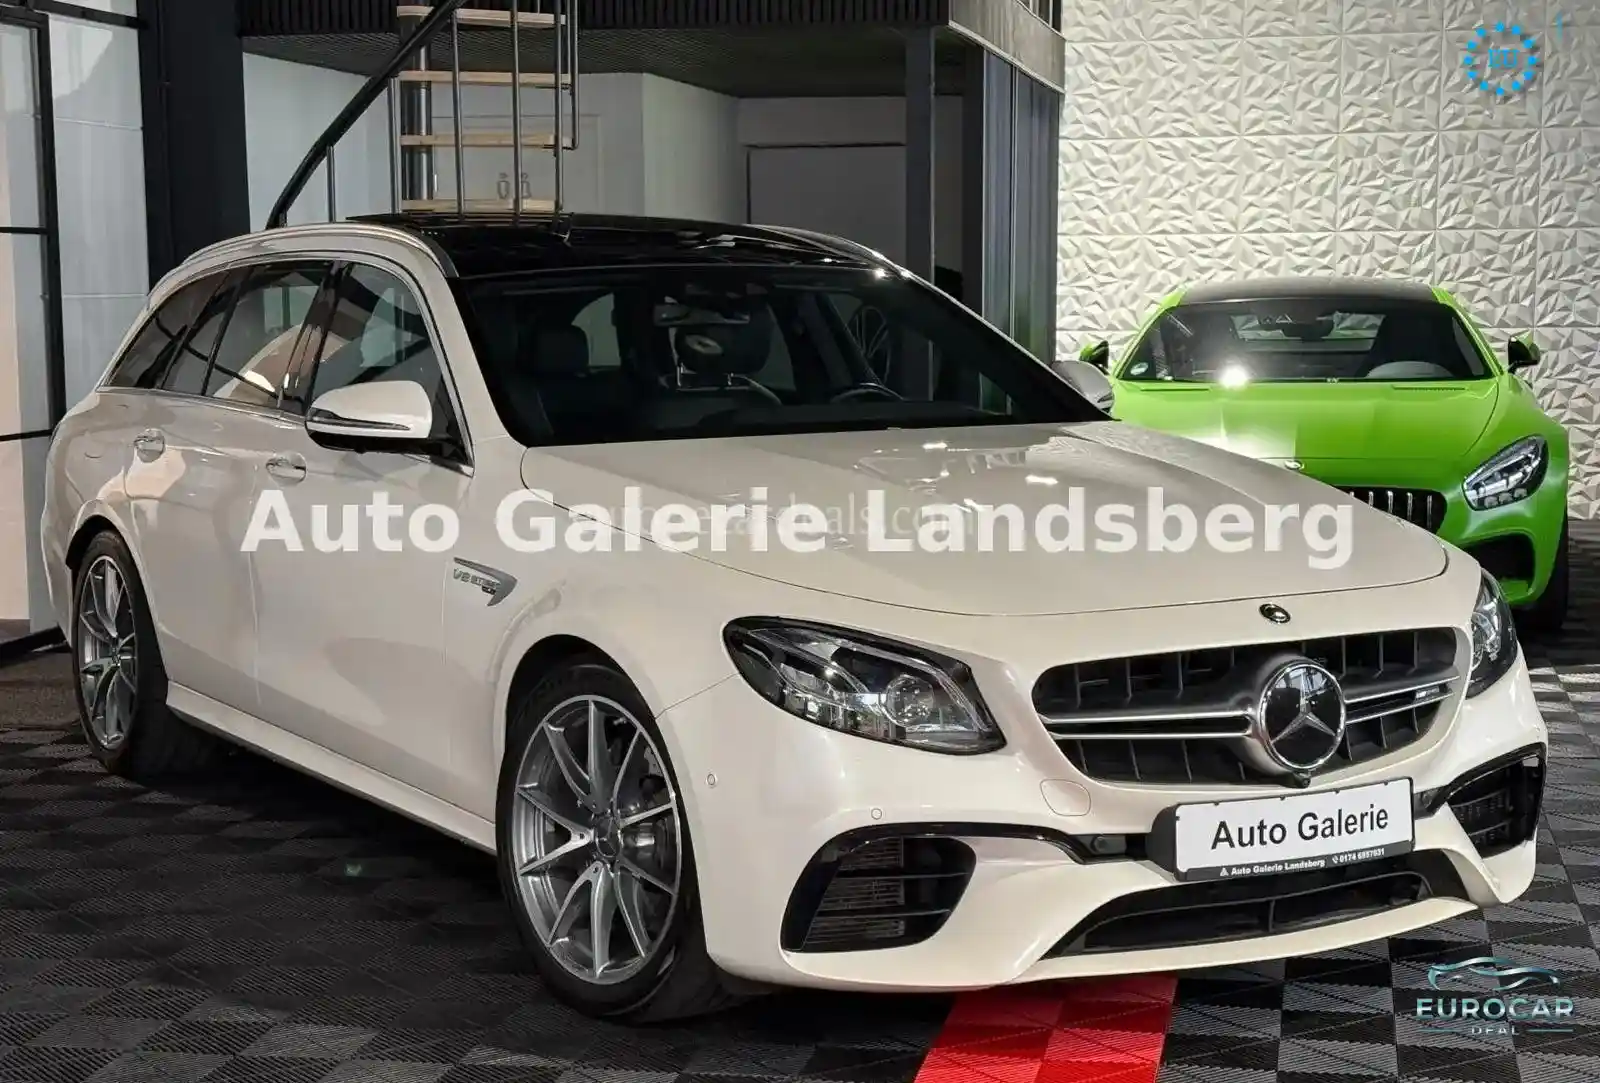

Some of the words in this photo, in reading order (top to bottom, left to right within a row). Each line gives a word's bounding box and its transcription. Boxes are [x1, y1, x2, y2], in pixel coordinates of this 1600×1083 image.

[1211, 820, 1287, 850] Auto
[1298, 804, 1389, 841] Galerie
[1231, 867, 1251, 876] Auto
[1253, 864, 1284, 874] Galerie
[1285, 858, 1326, 871] Landsberg
